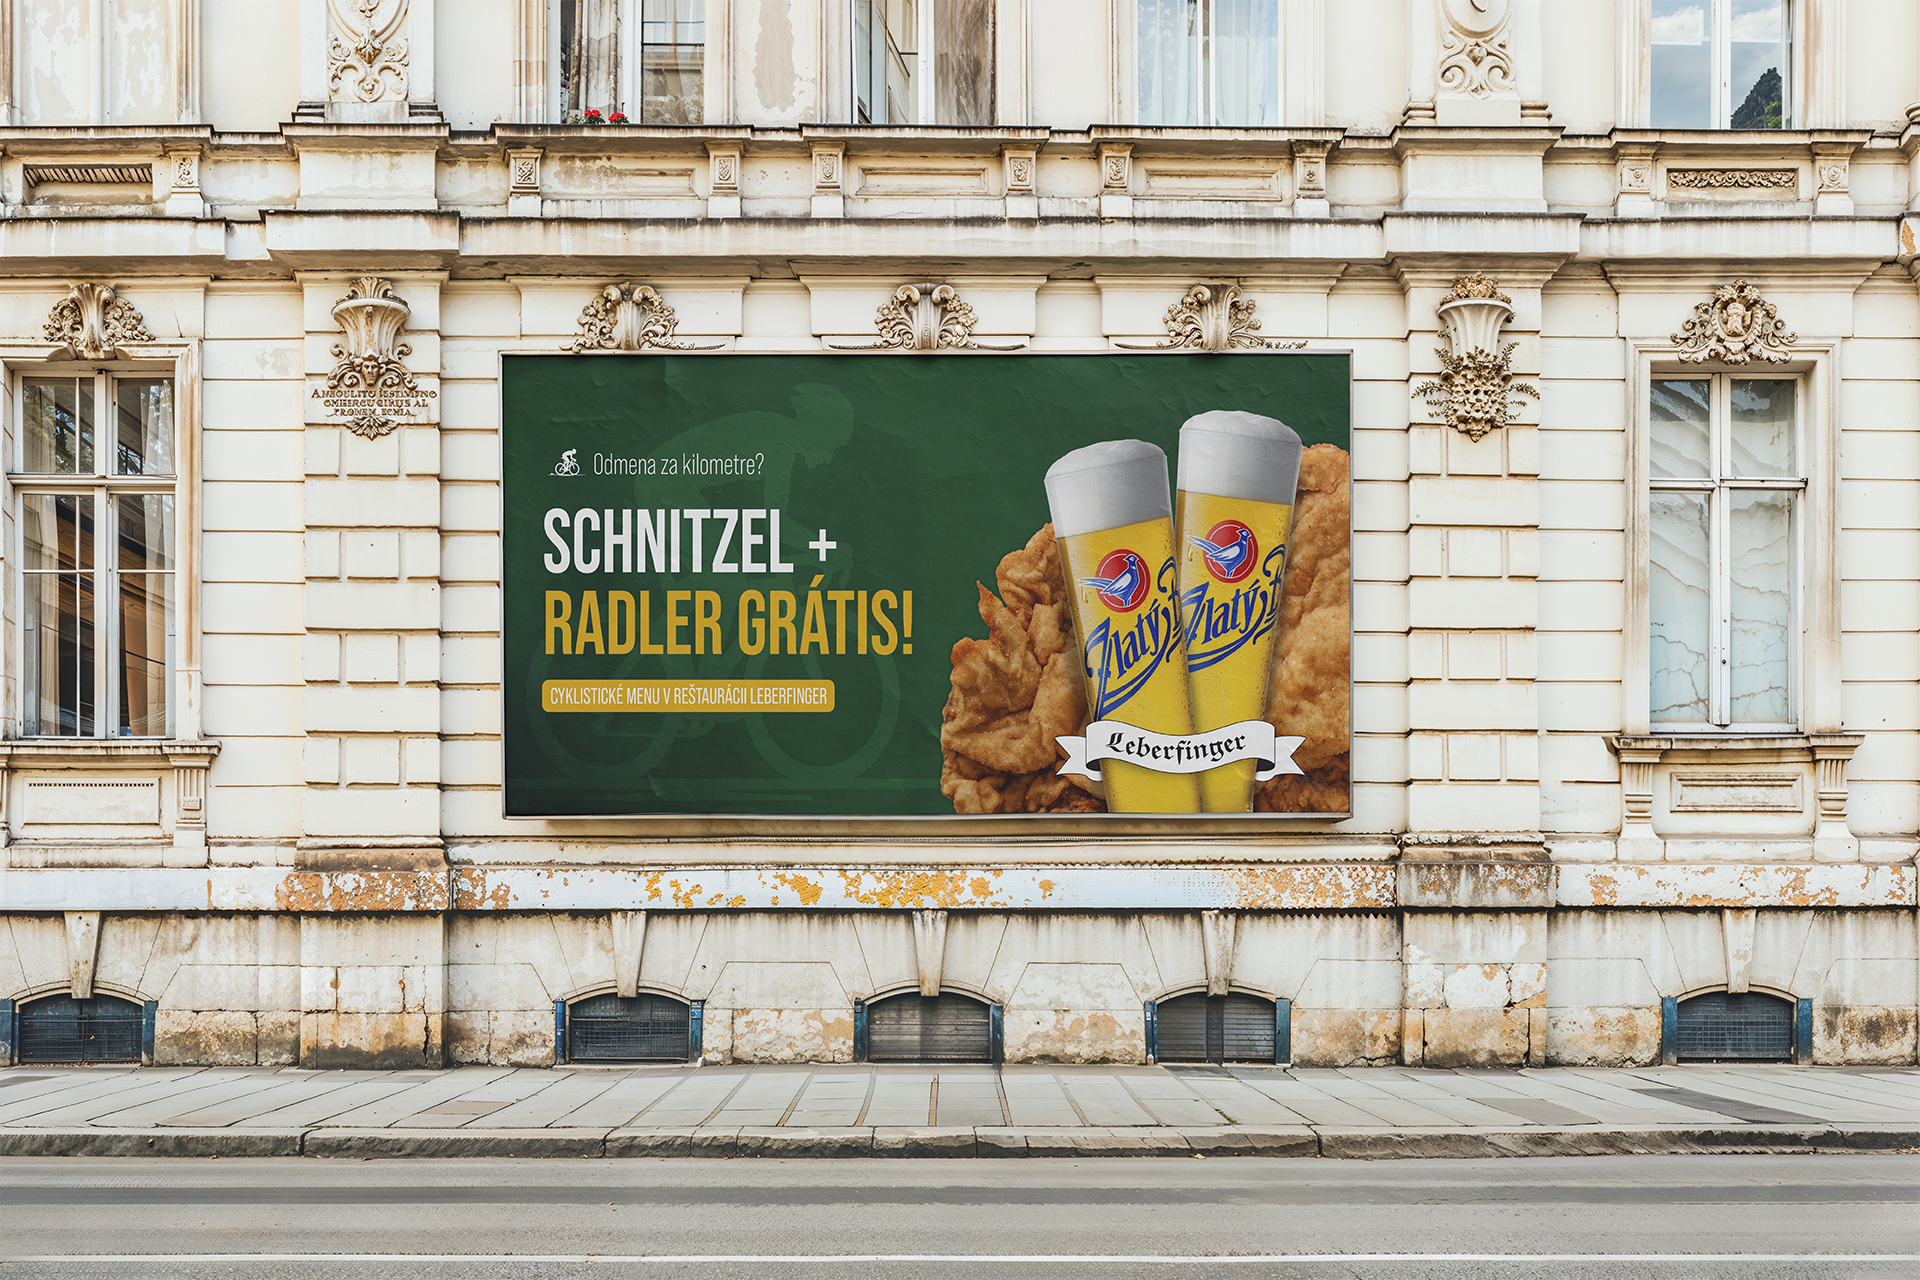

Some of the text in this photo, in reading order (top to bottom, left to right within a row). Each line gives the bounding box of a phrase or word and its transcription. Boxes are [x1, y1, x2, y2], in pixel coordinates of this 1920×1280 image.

[593, 452, 765, 476] Odmena za kilometre?
[543, 507, 837, 575] SCHNITZEL +
[544, 574, 914, 656] RADLER GRÁTIS!
[1085, 597, 1171, 722] Zlatý
[550, 684, 828, 705] CYKLISTICKÉ MENU V REŠTAURÁCII LEBERFINGER
[1105, 732, 1247, 765] Leberfinger
